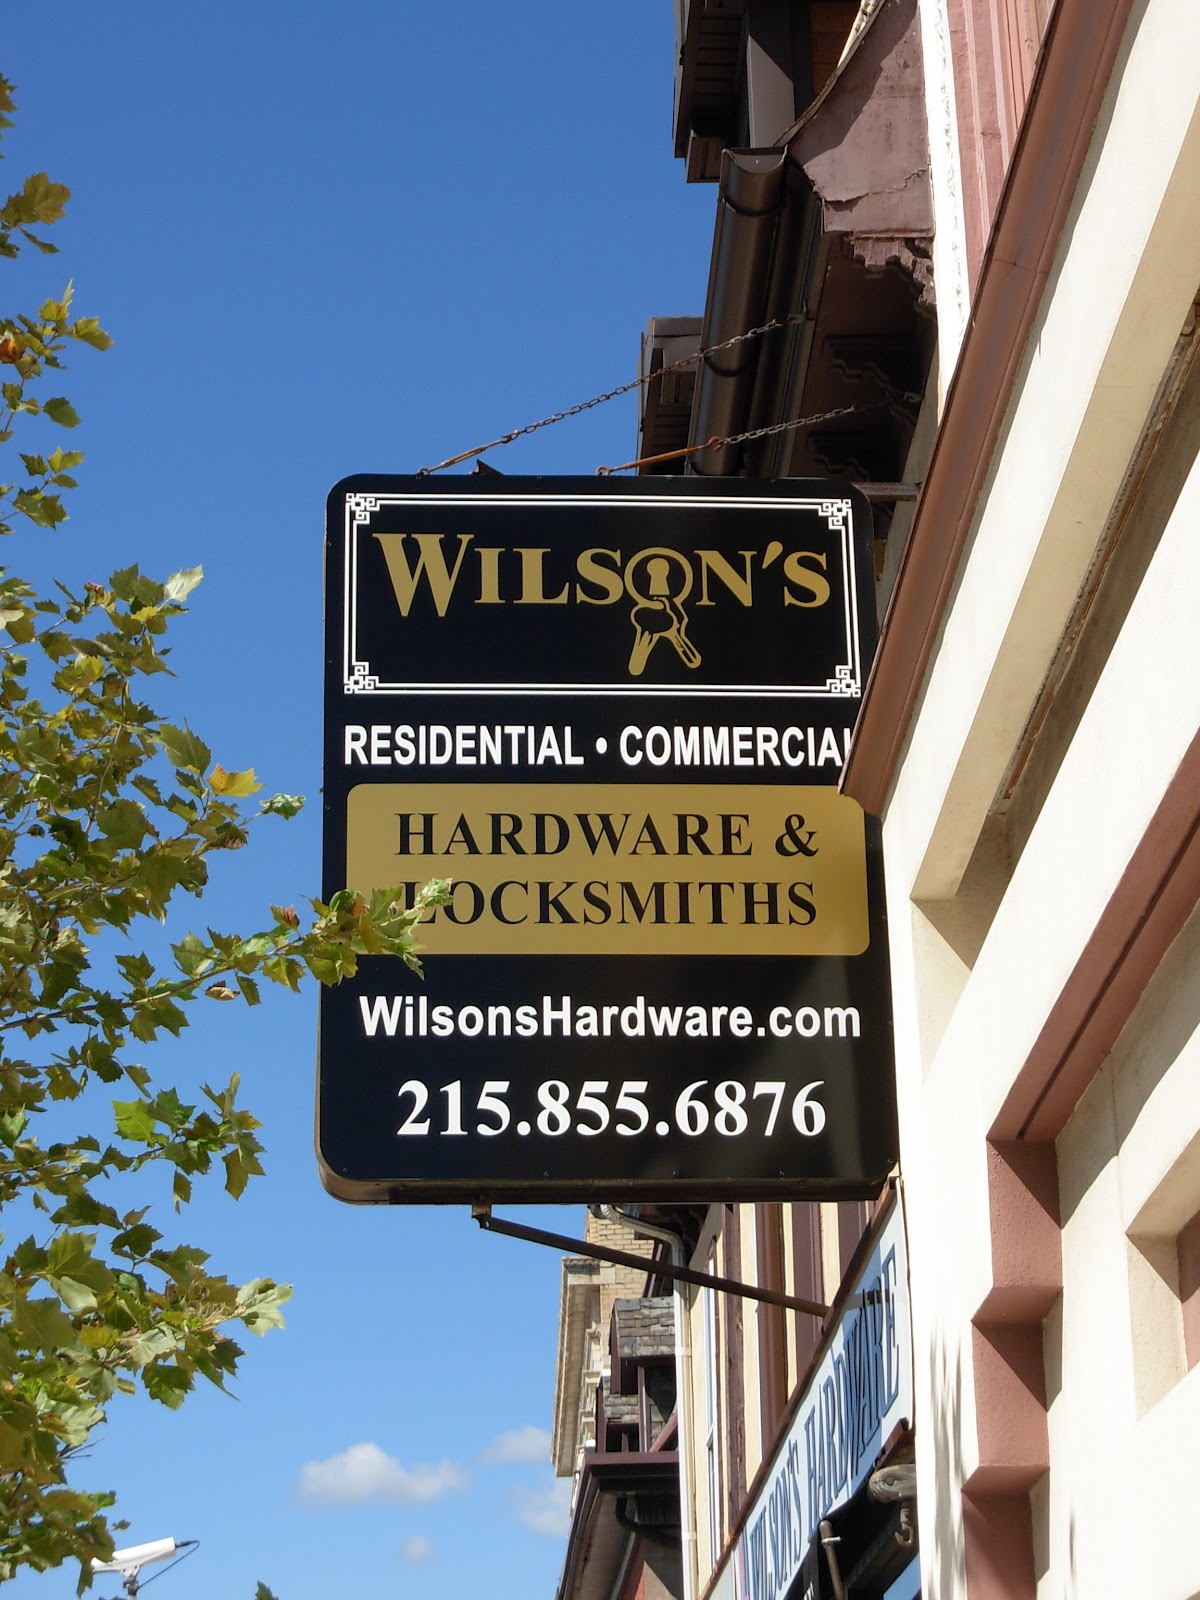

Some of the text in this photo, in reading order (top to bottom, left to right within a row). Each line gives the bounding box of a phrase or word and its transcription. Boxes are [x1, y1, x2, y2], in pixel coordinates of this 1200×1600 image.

[372, 532, 832, 618] WILSON'S
[344, 725, 585, 766] RESIDENTIAL
[394, 813, 819, 857] HARDWARE &
[400, 880, 817, 926] LOCKSMITHS
[358, 995, 861, 1038] WilsonsHardware.com
[396, 1079, 827, 1137] 215.855.6876
[804, 1243, 899, 1542] HARDWARE
